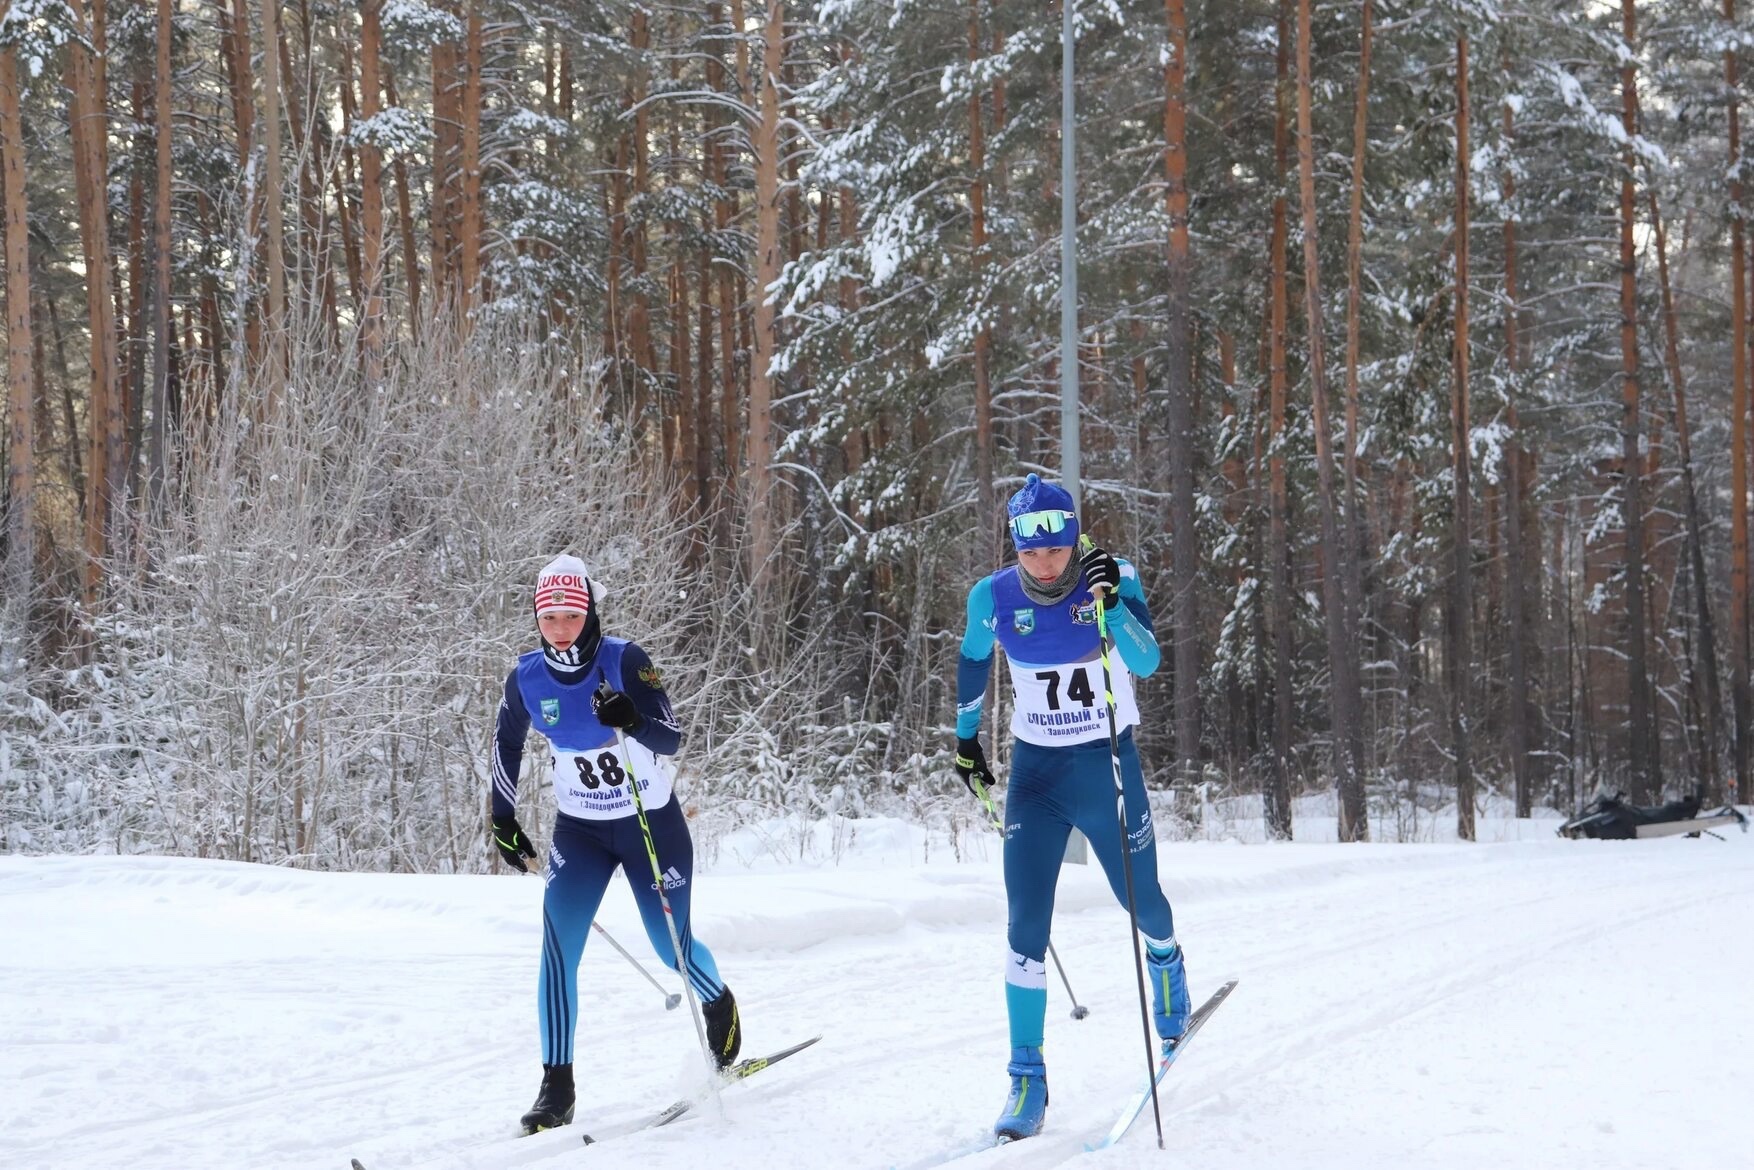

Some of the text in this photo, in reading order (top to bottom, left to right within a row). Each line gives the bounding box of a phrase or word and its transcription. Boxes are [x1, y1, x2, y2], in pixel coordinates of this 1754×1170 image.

[1035, 667, 1095, 710] 74
[1027, 709, 1091, 726] СОСНОВЫЙ
[574, 751, 625, 789] 88
